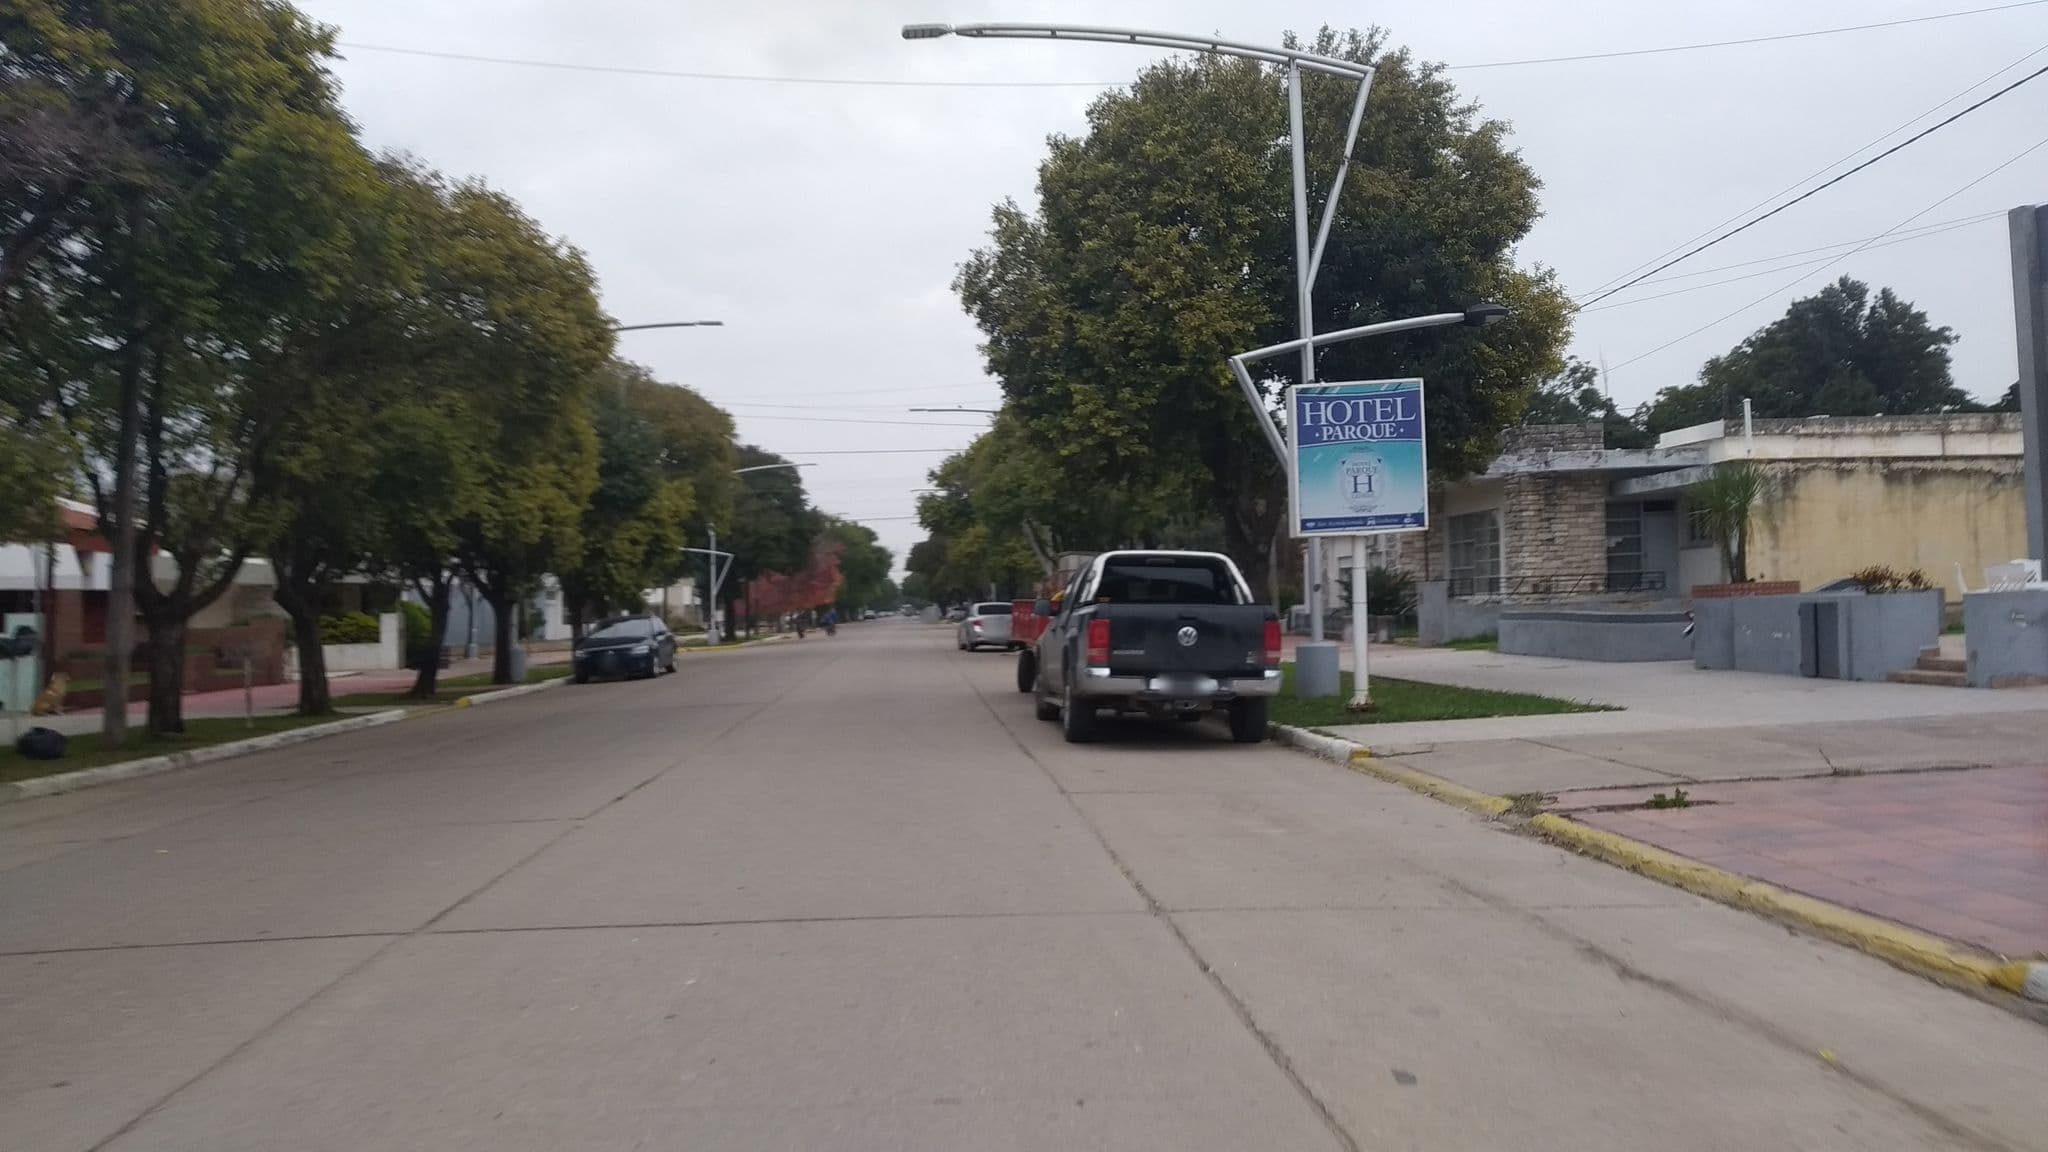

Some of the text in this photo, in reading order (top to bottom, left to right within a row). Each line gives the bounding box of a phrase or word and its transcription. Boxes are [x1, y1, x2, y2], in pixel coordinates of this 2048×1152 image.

[1302, 396, 1416, 426] HOTEL
[1321, 422, 1397, 442] PARQUE
[1352, 475, 1374, 493] H
